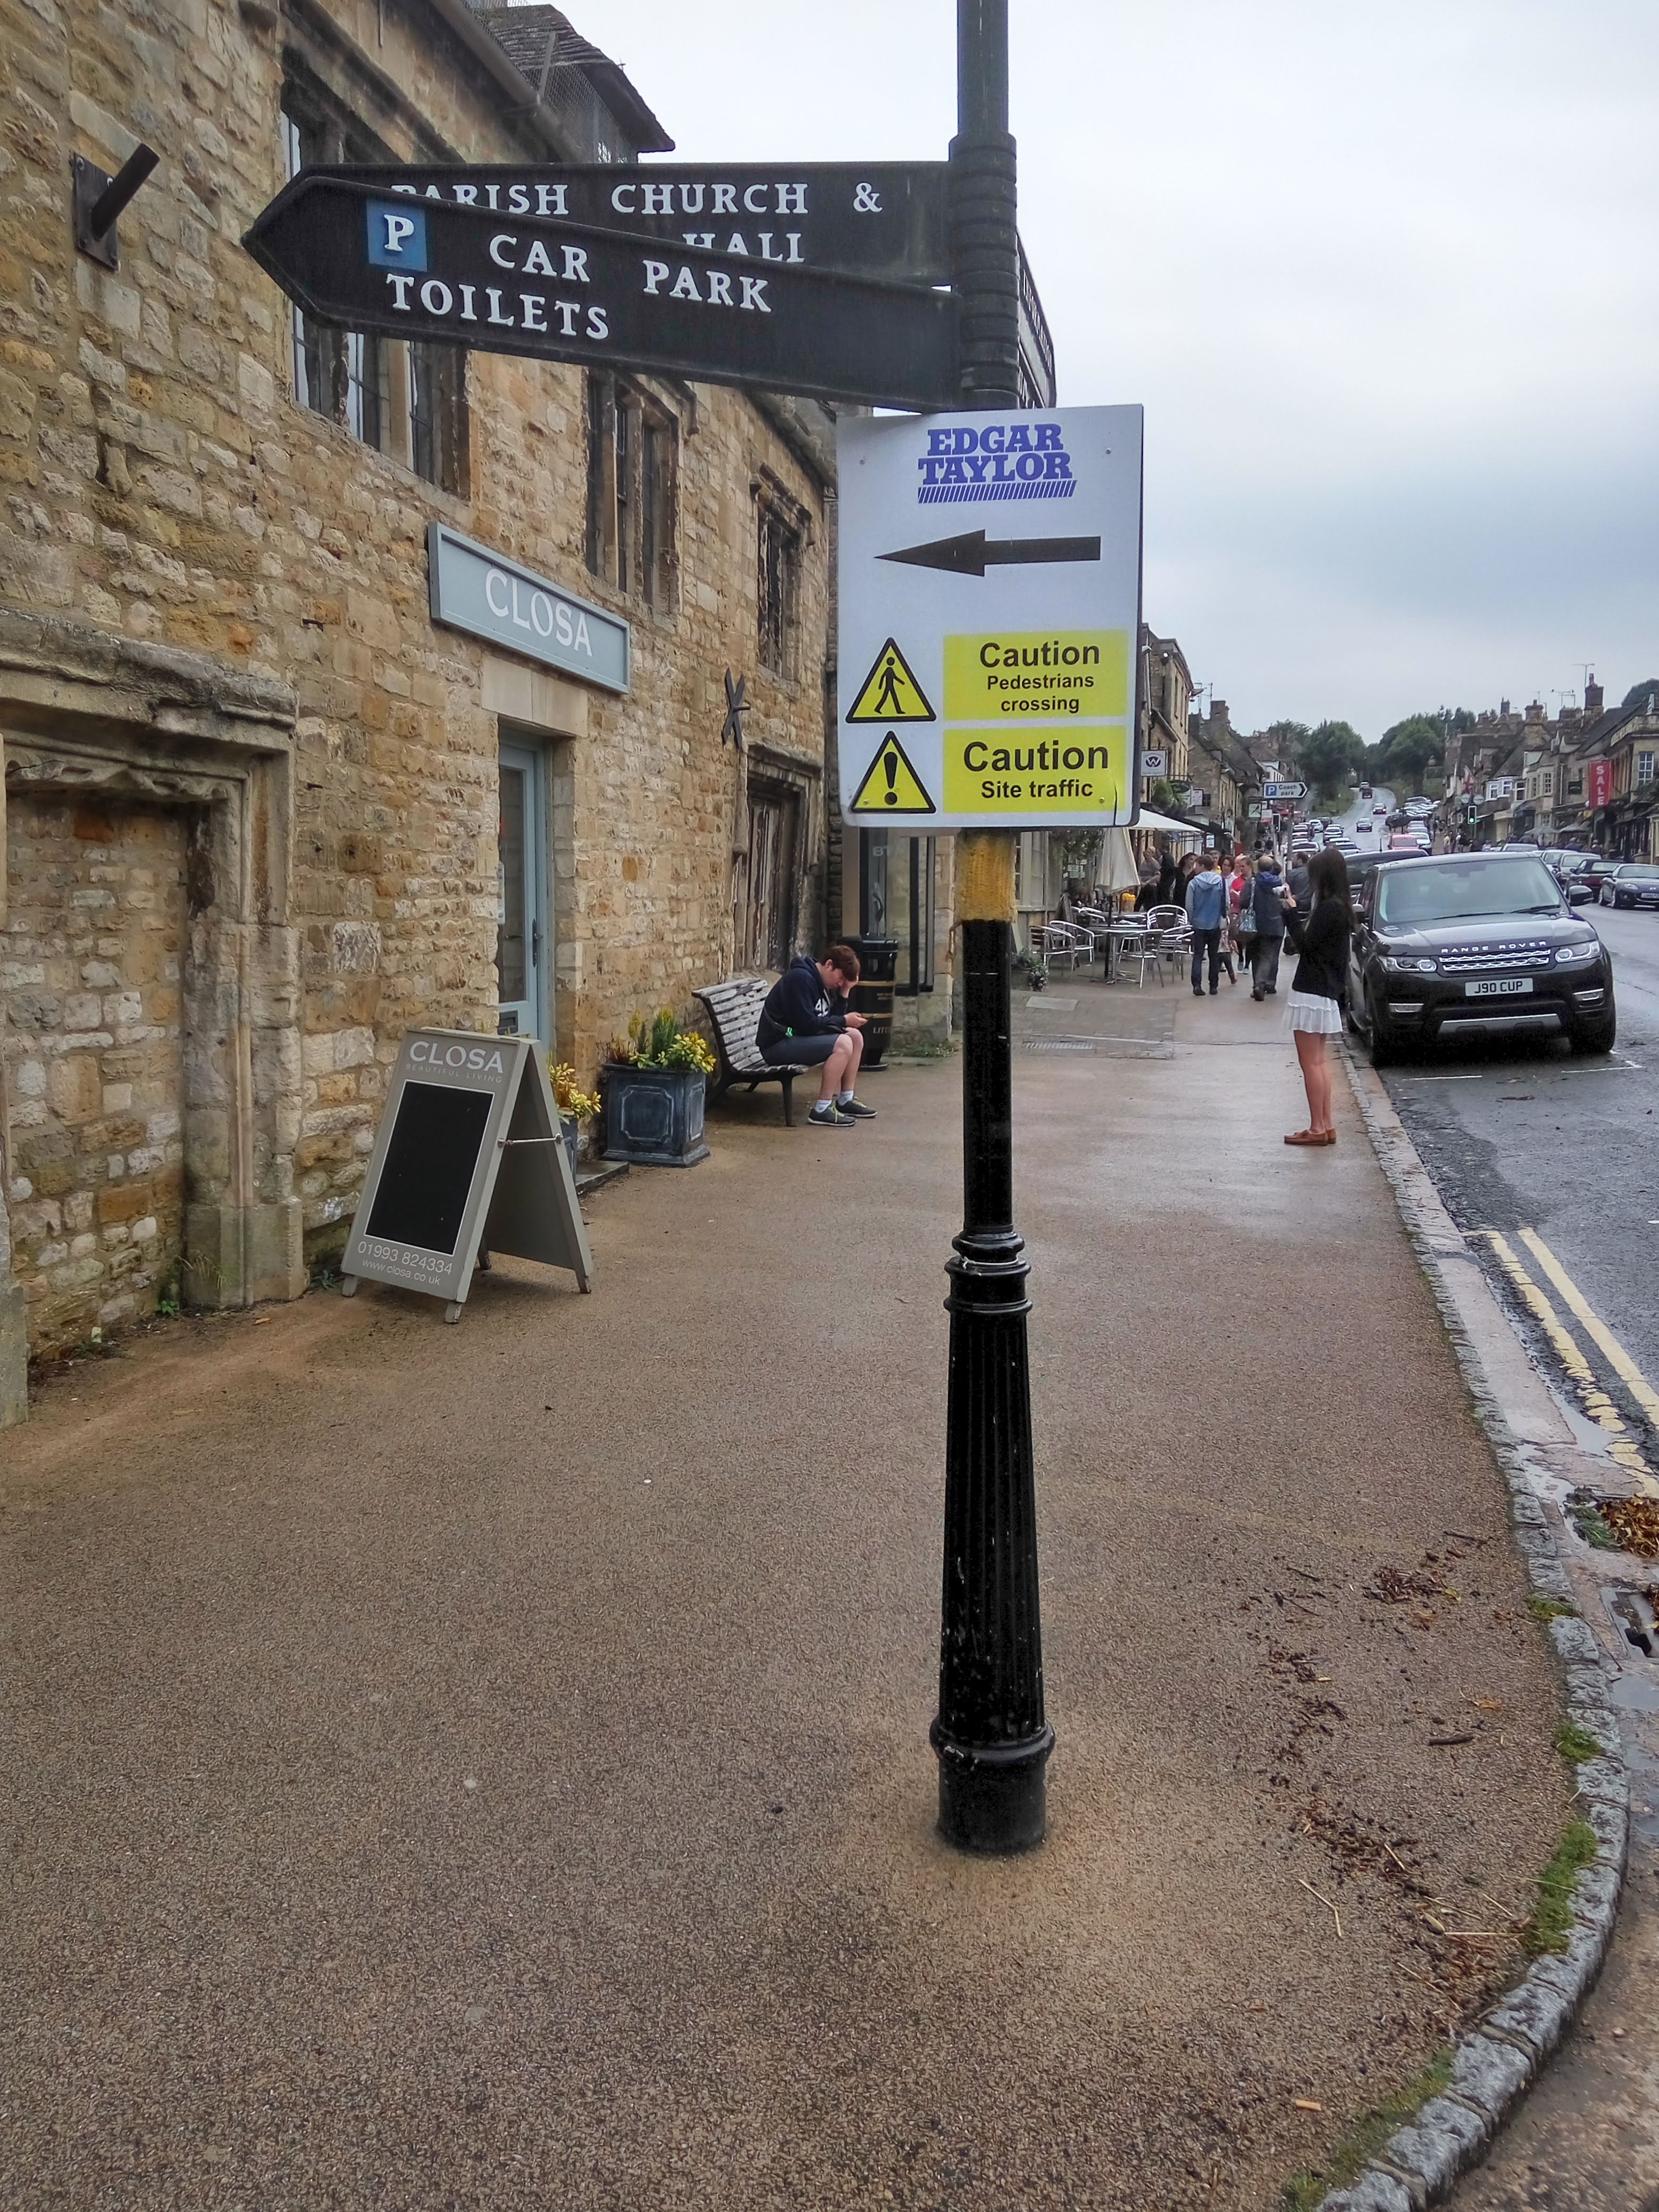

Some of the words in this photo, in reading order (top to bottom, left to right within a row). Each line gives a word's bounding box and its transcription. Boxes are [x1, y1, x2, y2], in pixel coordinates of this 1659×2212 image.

[611, 183, 808, 214] CHURCH
[853, 182, 883, 212] &
[383, 214, 415, 252] P
[489, 234, 590, 282] CAR
[642, 259, 772, 312] PARK
[386, 273, 609, 340] TOILETS
[927, 423, 1063, 456] EDGAR
[918, 451, 1072, 485] TAYLOR
[485, 568, 592, 657] CLOSA
[979, 641, 1100, 668] Caution
[987, 674, 1094, 691] Pedestrians
[1000, 697, 1079, 714] crossing
[963, 741, 1109, 772] Caution
[981, 781, 1022, 799] Site
[1029, 778, 1093, 798] traffic
[1268, 786, 1276, 795] P
[1596, 766, 1605, 805] SALE
[1499, 941, 1546, 950] ROVER
[1474, 983, 1496, 994] J90
[1500, 981, 1523, 992] CUP
[409, 1041, 503, 1073] CLOSA
[406, 1063, 460, 1077] BEAUTIFUL
[466, 1073, 502, 1083] LIVING
[358, 1241, 398, 1261] 01993
[401, 1252, 452, 1275] 824334
[363, 1259, 441, 1285] www.closa.co.uk
